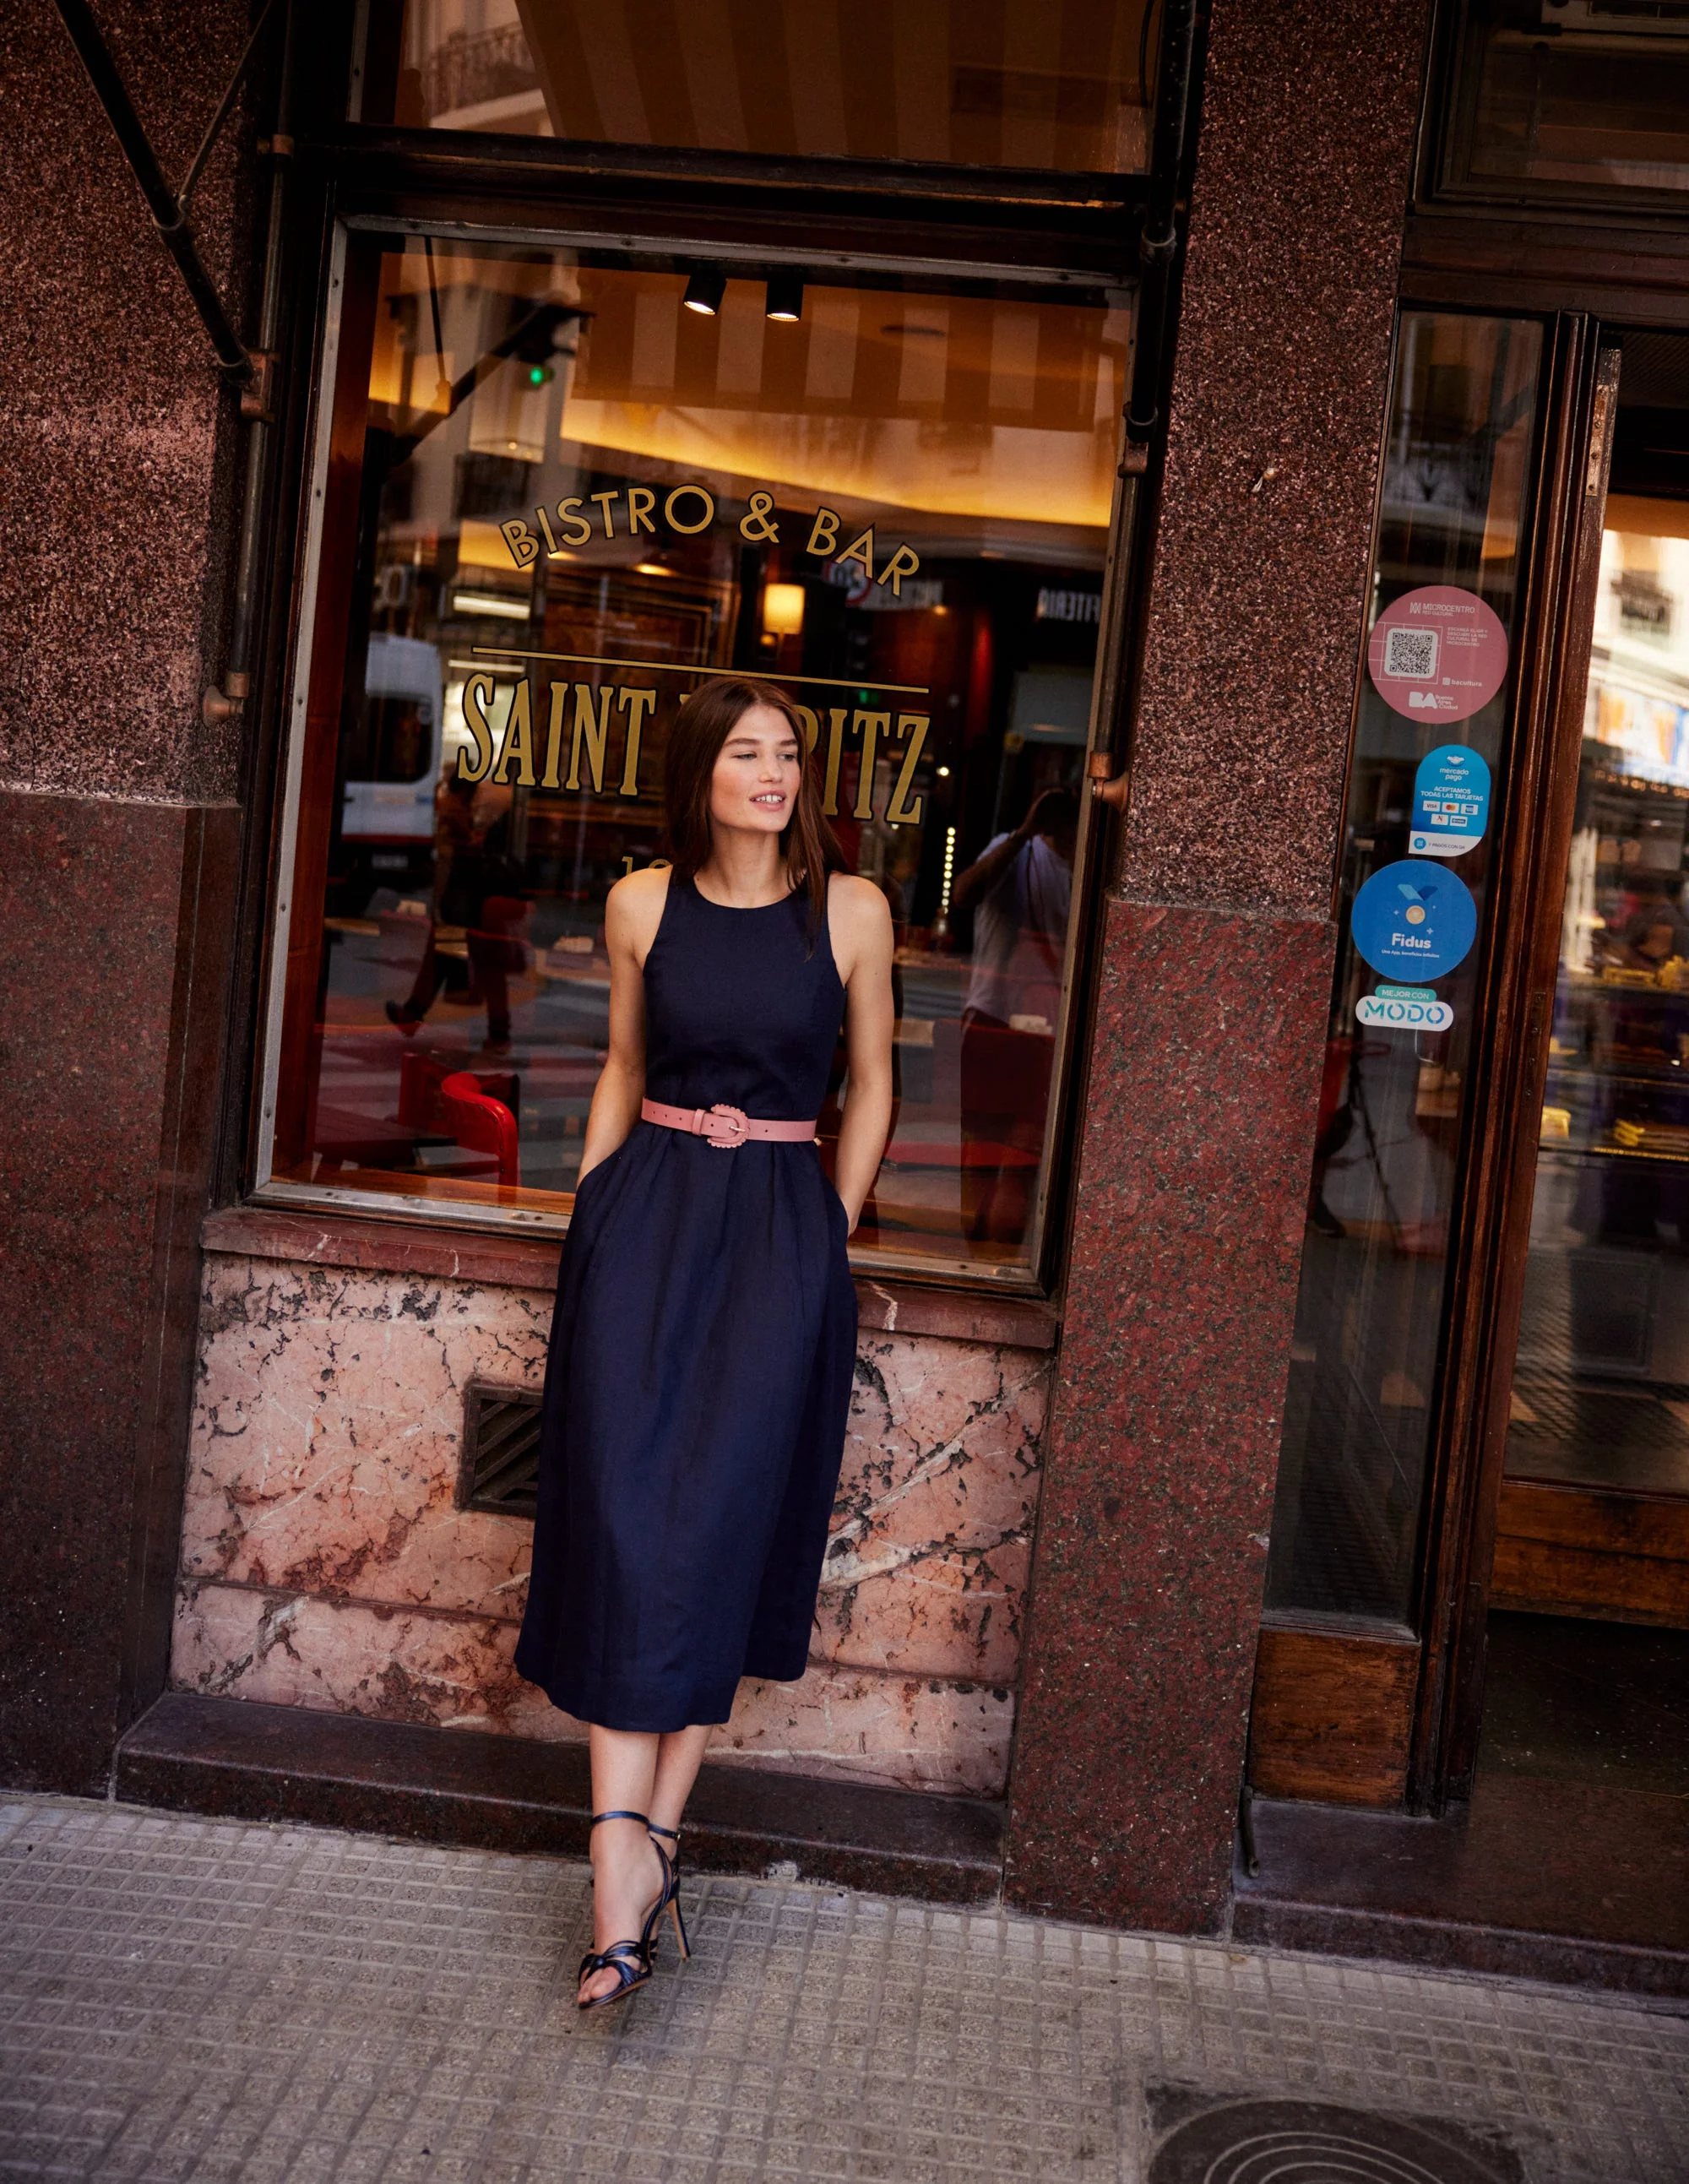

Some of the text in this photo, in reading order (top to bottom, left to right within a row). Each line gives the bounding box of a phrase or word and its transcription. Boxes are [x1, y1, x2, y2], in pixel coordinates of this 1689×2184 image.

[500, 485, 920, 595] BISTRO & BAR
[1423, 603, 1475, 614] MICROCENTRO
[1409, 691, 1437, 709] BA
[457, 674, 657, 796] SAINT
[1392, 932, 1431, 949] Fidus
[1382, 989, 1430, 1000] MEJOR CON
[1365, 1000, 1445, 1024] MODO
